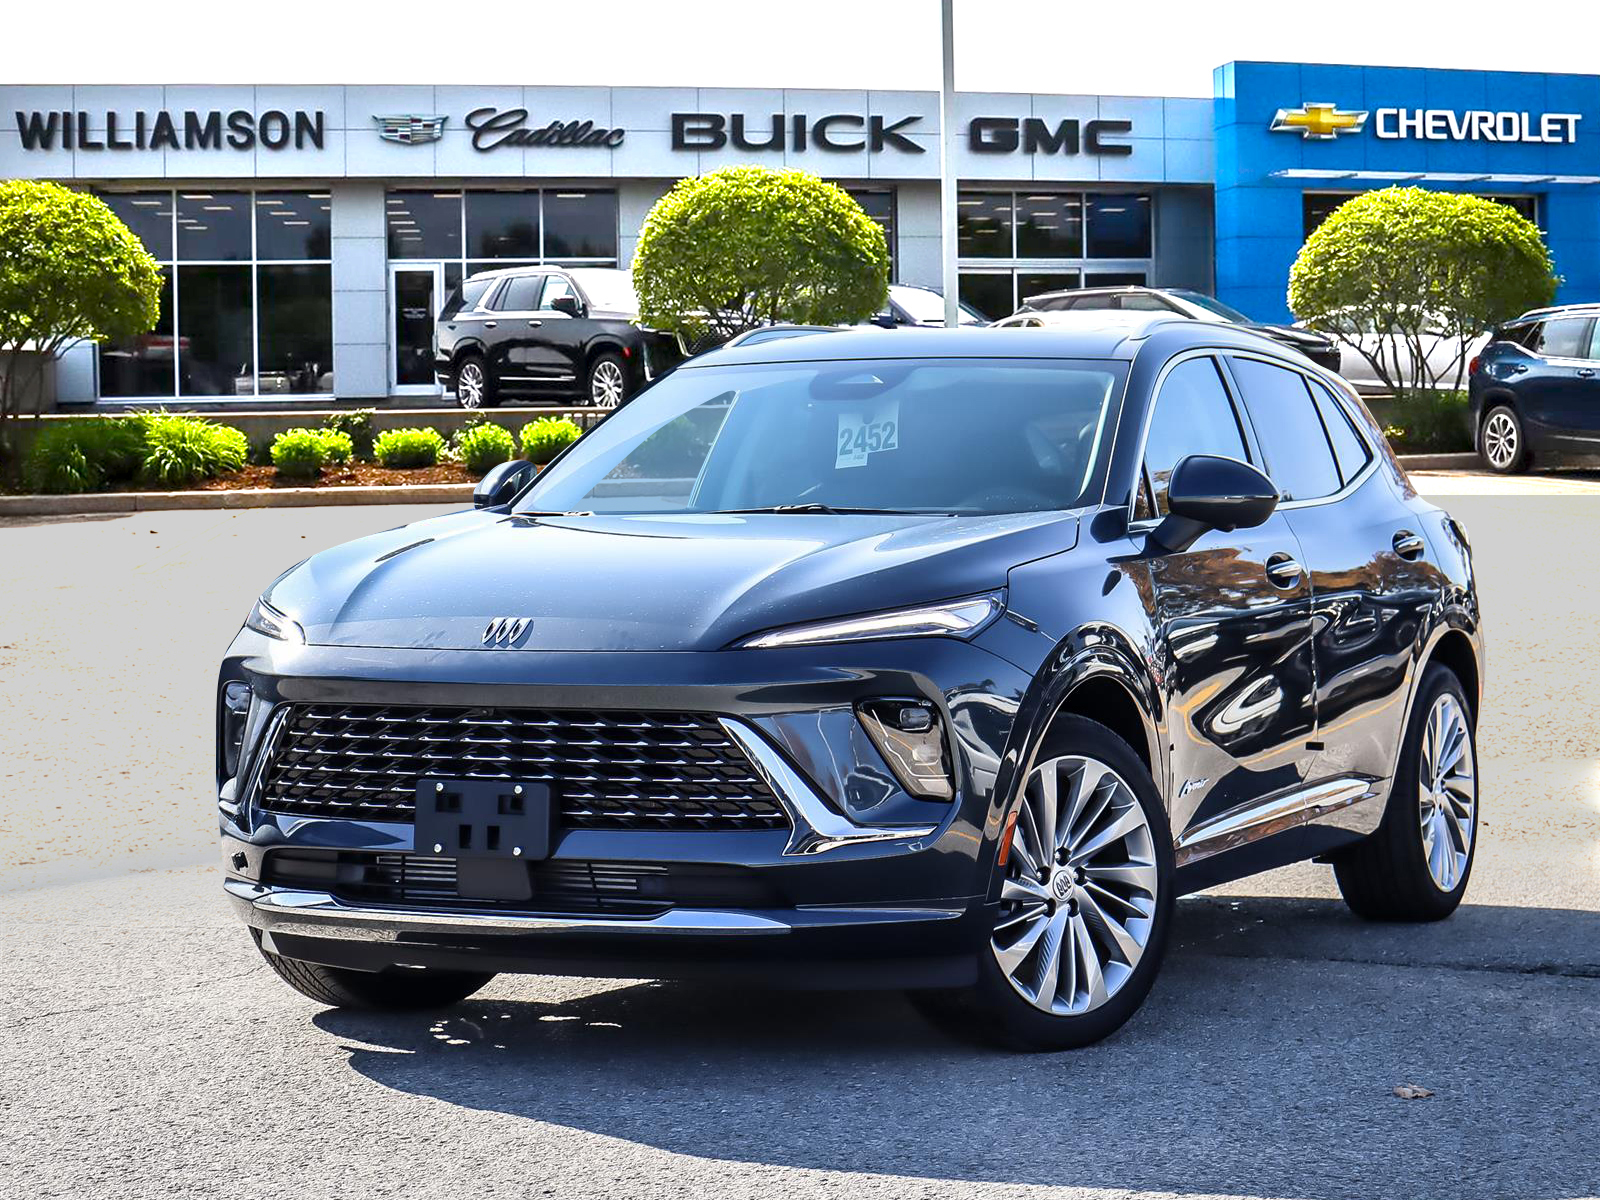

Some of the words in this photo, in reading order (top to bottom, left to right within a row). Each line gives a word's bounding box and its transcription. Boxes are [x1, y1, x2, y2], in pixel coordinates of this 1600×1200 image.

[15, 110, 325, 150] WILLIAMSON
[465, 107, 625, 152] Cadillac
[671, 112, 926, 153] BUICK
[969, 117, 1133, 156] GMC
[1375, 108, 1582, 144] CHEVROLET
[840, 421, 896, 455] 2452
